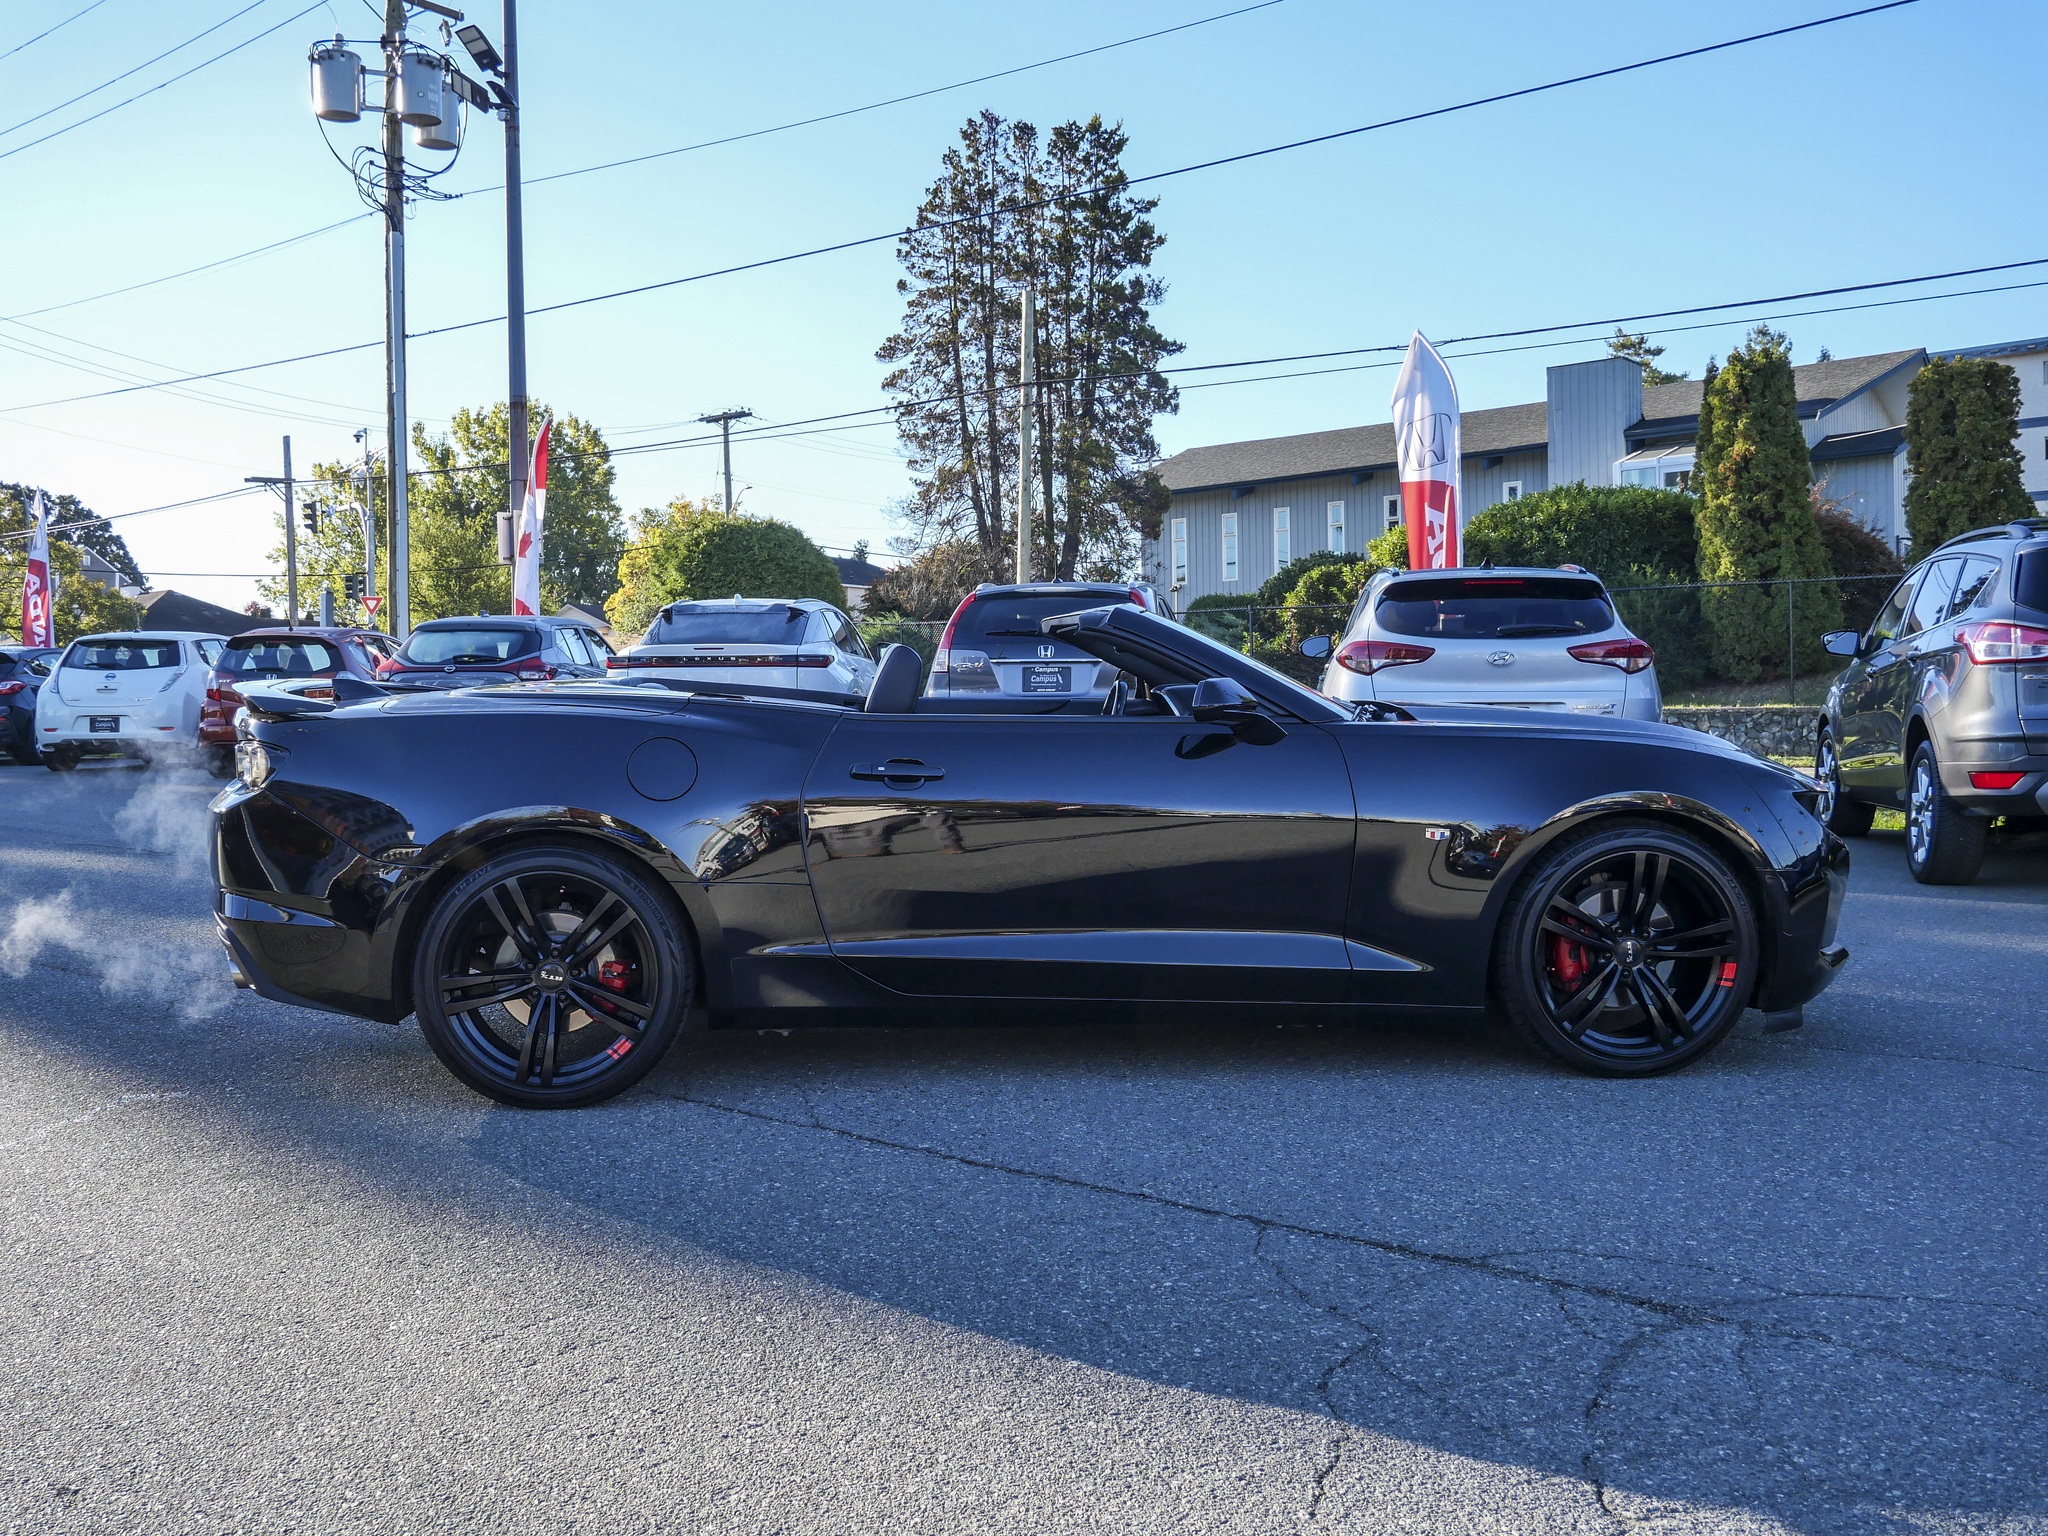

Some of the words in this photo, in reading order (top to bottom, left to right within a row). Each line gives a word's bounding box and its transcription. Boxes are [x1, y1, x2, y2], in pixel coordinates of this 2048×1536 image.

[428, 92, 438, 102] 100
[1031, 675, 1057, 683] Campus
[454, 863, 495, 895] LH-FIVE
